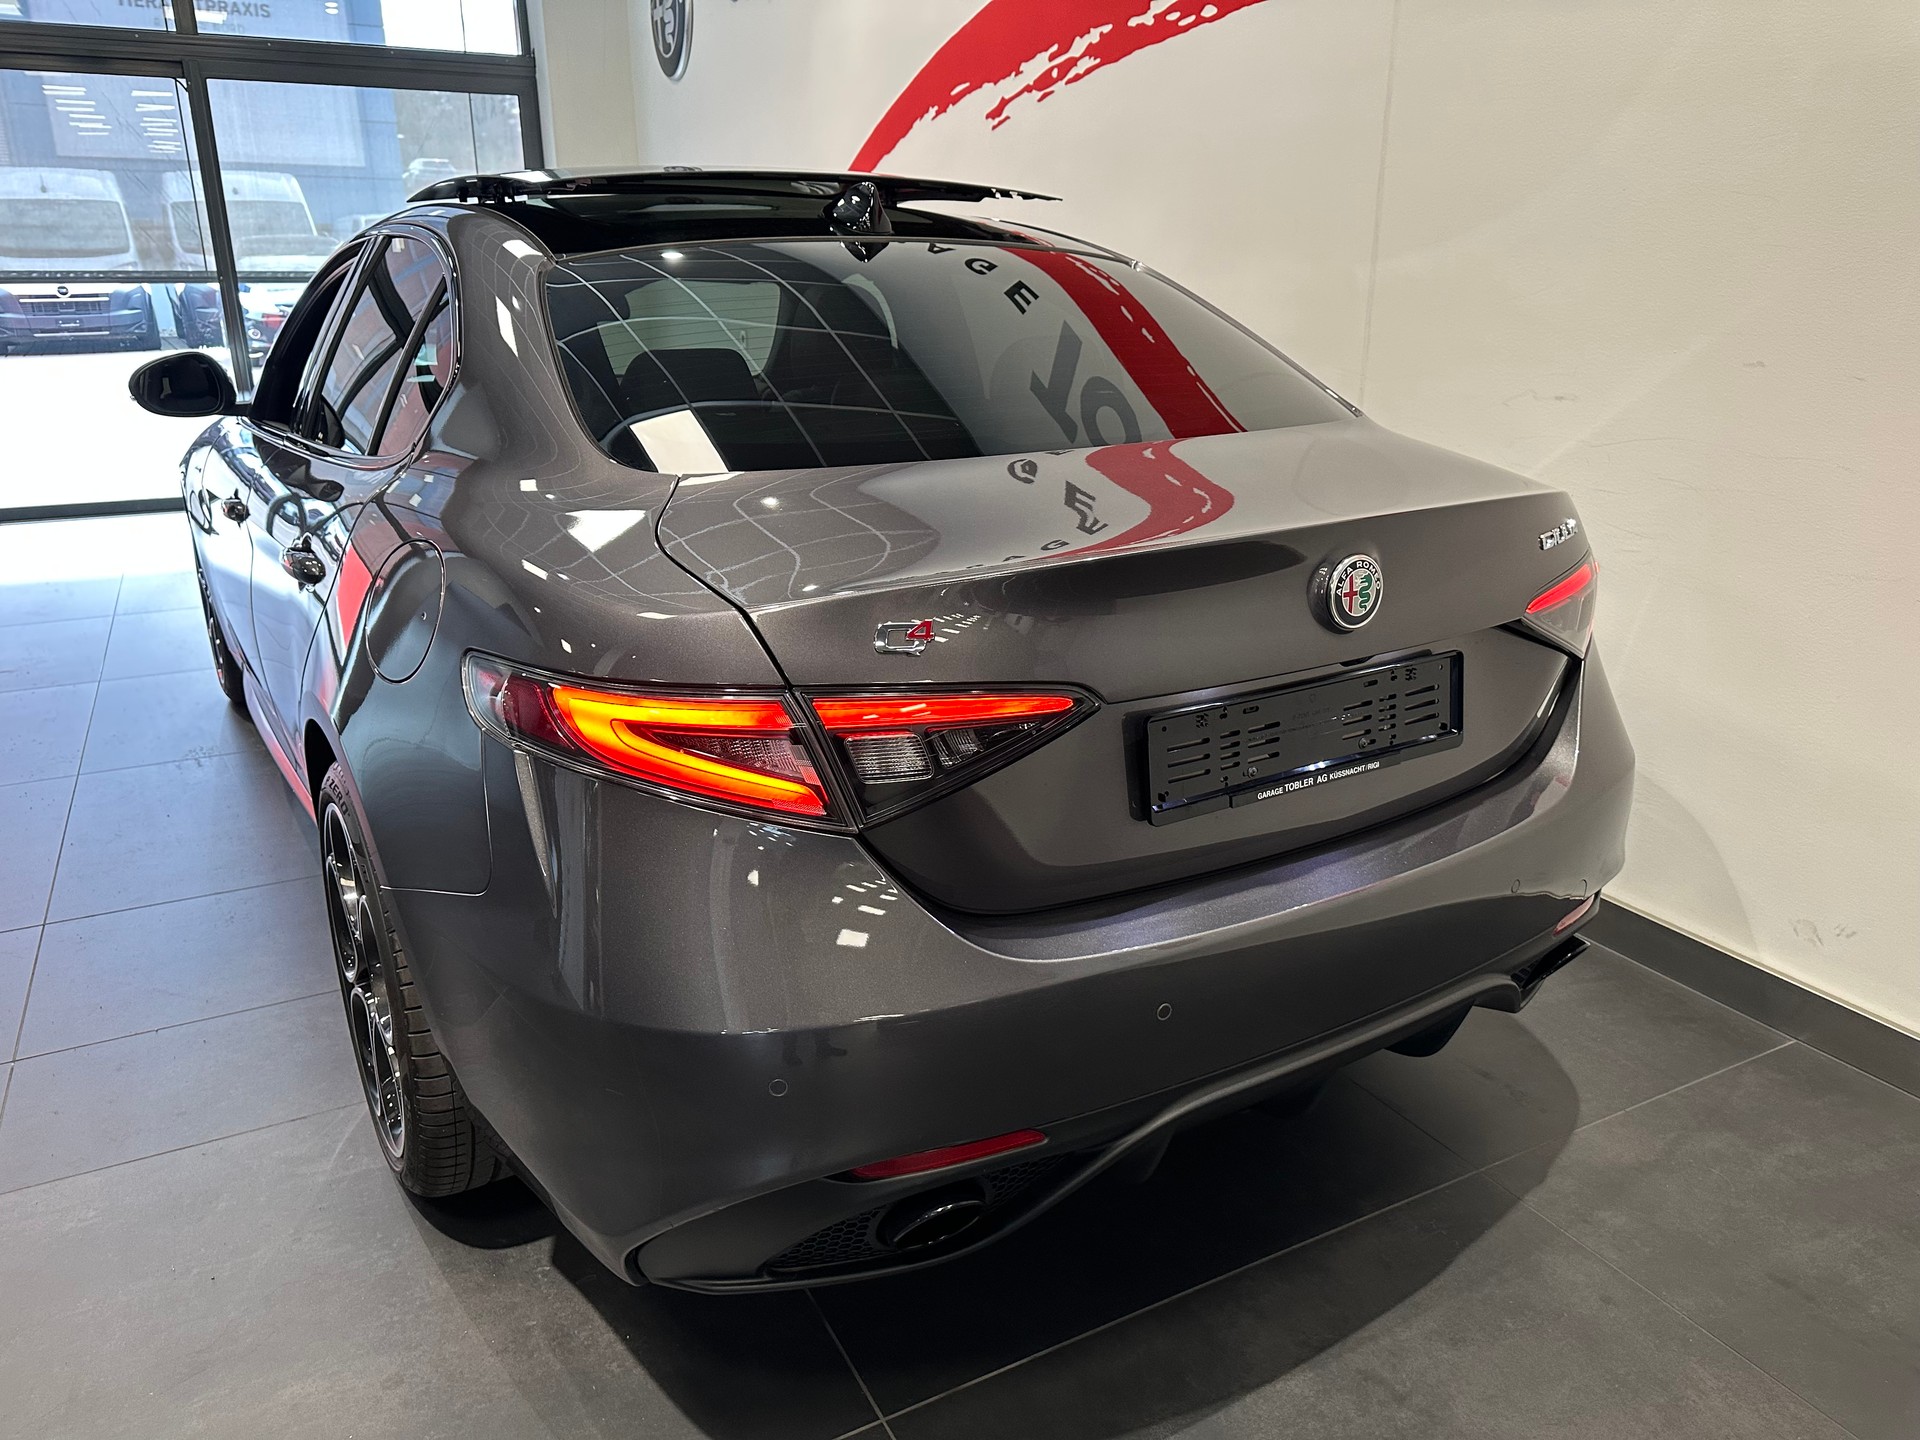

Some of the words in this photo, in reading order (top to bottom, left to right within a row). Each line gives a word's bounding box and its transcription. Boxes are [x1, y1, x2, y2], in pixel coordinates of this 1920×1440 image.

[1336, 567, 1353, 596] ALFA
[1356, 561, 1380, 590] ROMEO
[1257, 787, 1284, 800] GARAGE
[1284, 777, 1314, 792] TOBLER
[1317, 774, 1328, 784] AG
